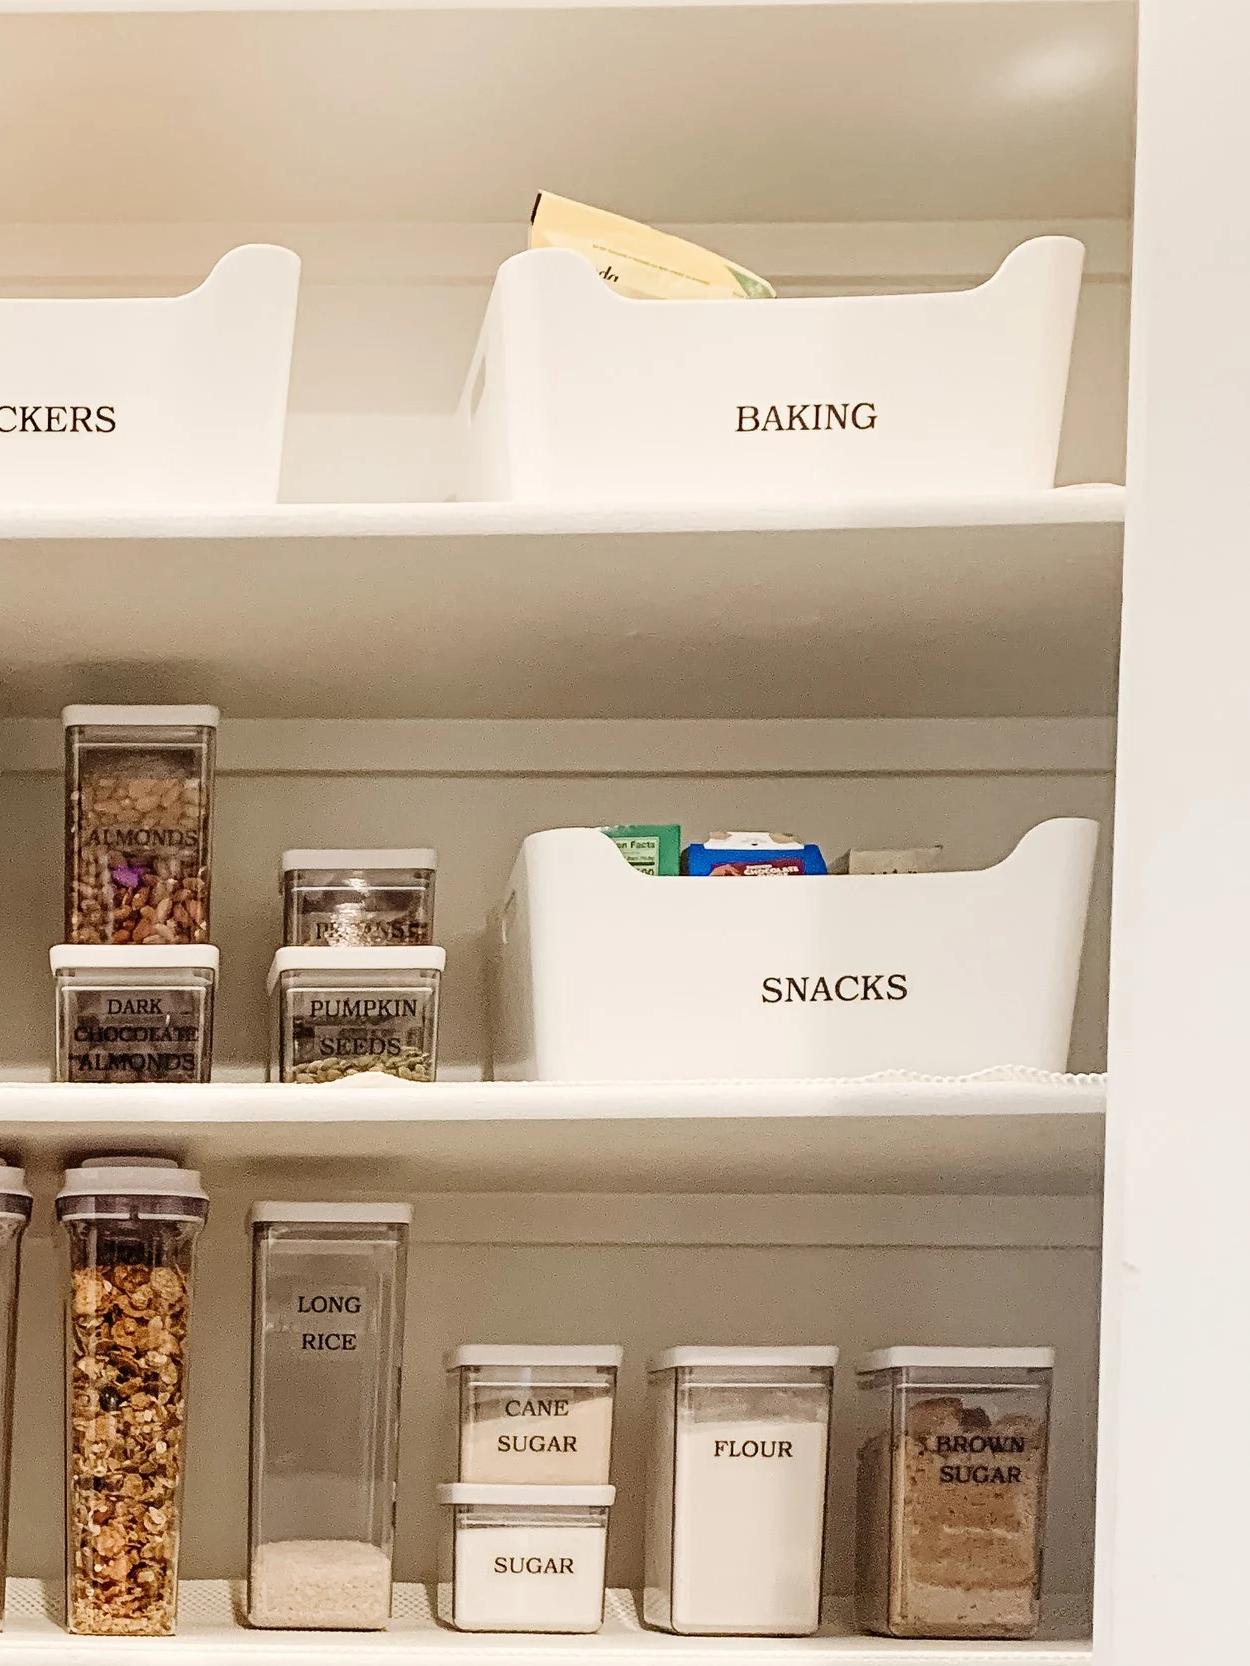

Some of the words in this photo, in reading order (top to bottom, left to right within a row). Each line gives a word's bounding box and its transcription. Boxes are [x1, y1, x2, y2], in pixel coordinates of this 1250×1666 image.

[735, 401, 879, 433] BAKING
[88, 829, 200, 848] ALMONDS
[630, 841, 656, 849] Facts
[762, 973, 909, 1004] SNACKS
[107, 999, 164, 1015] DARK
[310, 999, 418, 1019] PUMPKIN
[73, 1026, 200, 1044] CHOCOLATE
[319, 1037, 402, 1057] SEEDS
[76, 1052, 197, 1072] ALMONDS
[297, 1295, 362, 1315] LONG
[301, 1333, 358, 1351] RICE
[505, 1399, 570, 1417] CANE
[497, 1435, 578, 1453] SUGAR
[713, 1439, 794, 1458] FLOUR
[934, 1435, 1027, 1455] BROWN
[939, 1464, 1023, 1484] SUGAR
[494, 1557, 575, 1575] SUGAR
